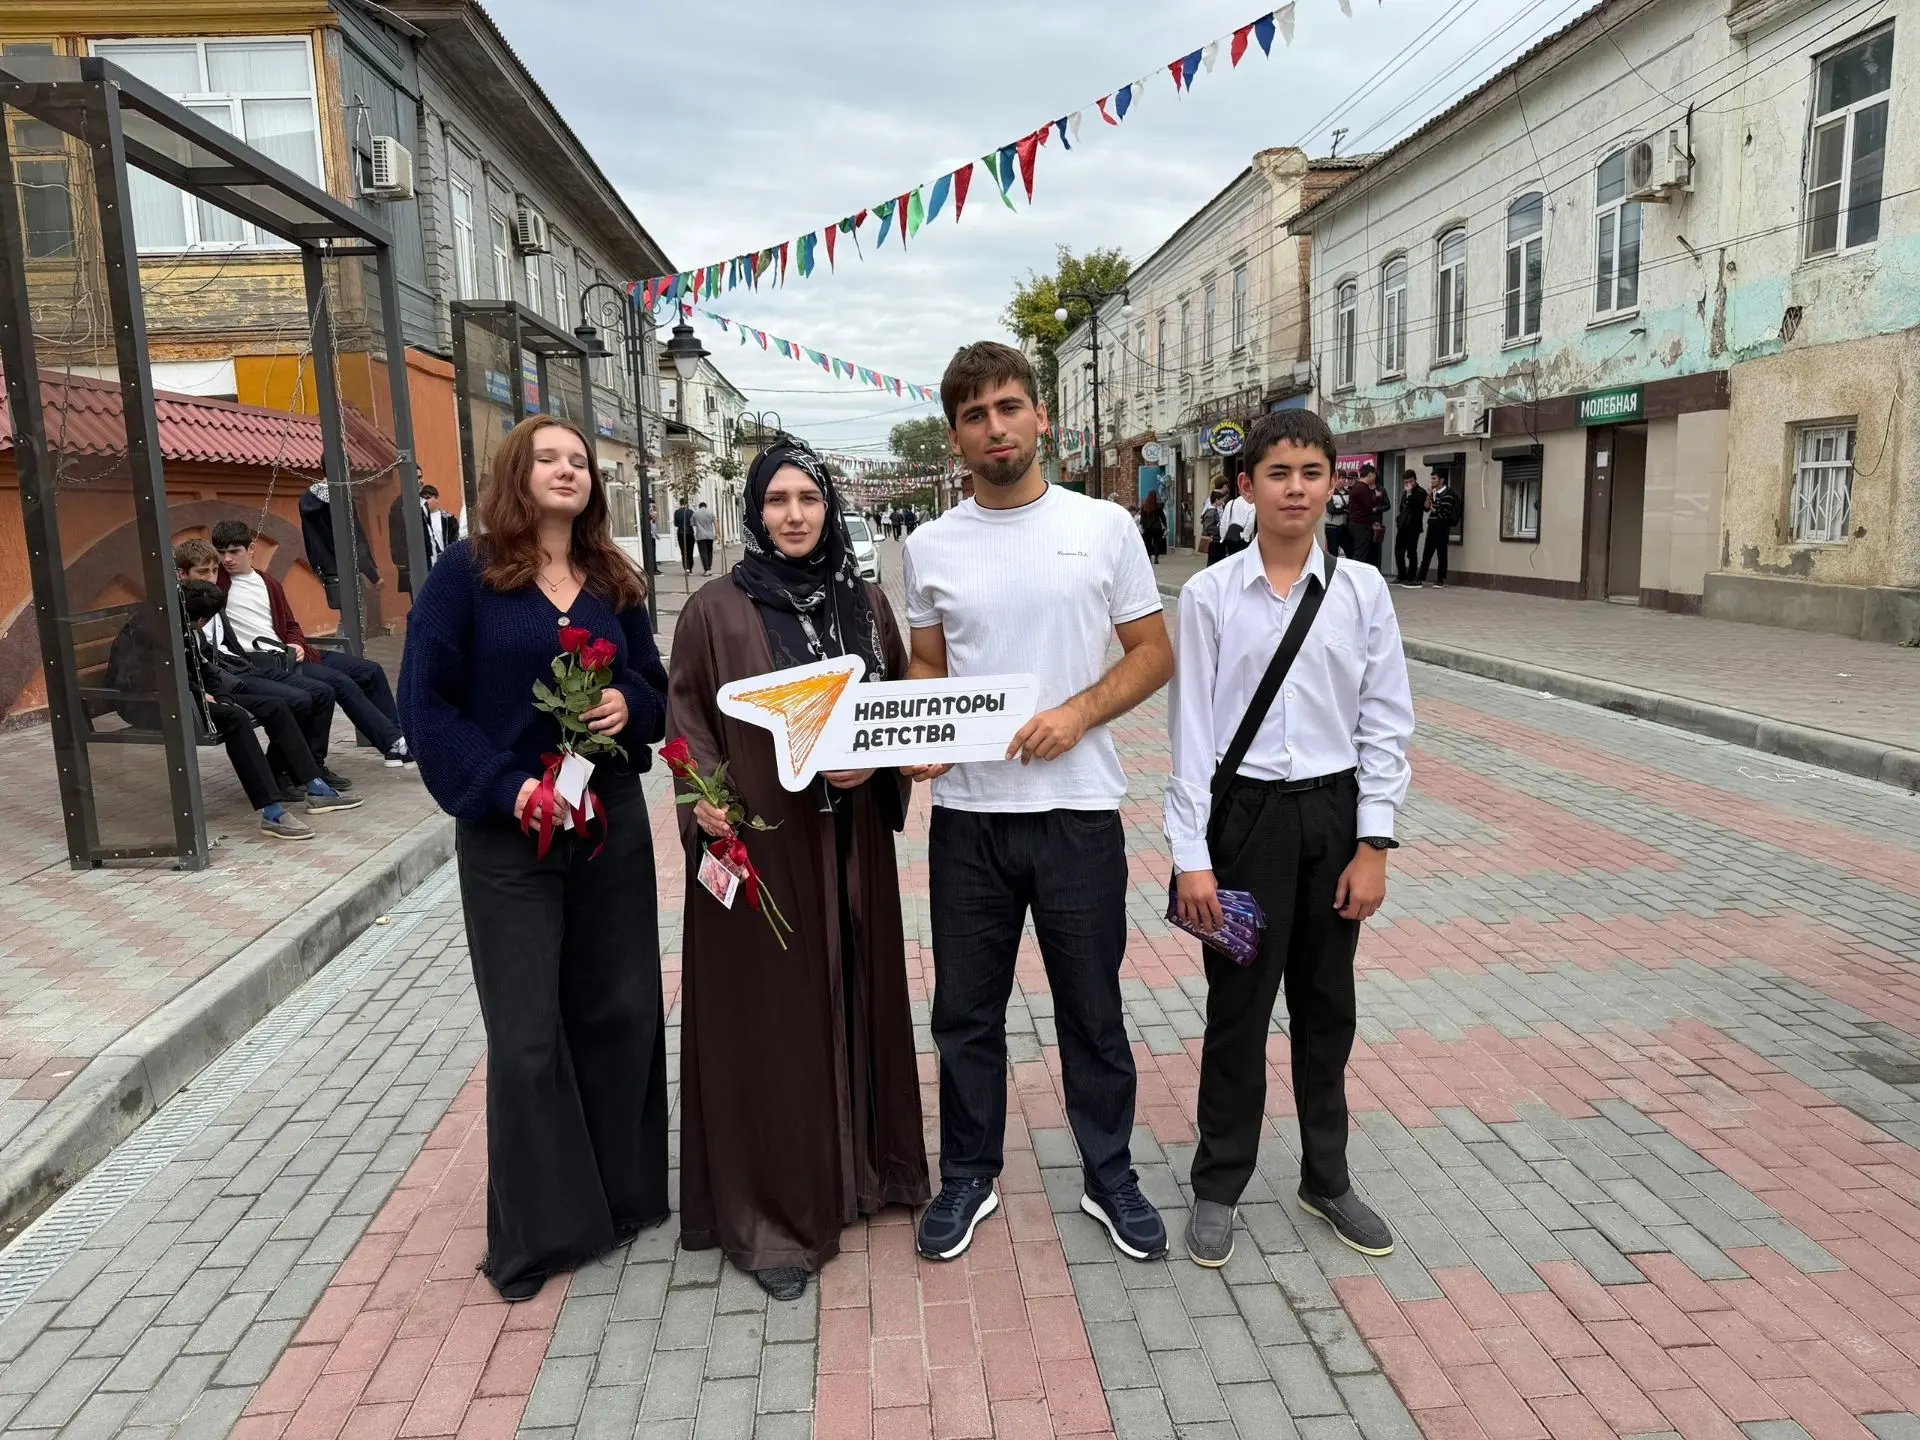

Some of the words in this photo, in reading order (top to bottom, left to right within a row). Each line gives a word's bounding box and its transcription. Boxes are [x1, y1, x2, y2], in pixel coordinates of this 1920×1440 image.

[1580, 392, 1638, 419] МОЛЕБНАЯ
[854, 693, 1005, 722] НАВИГАТОРЫ
[852, 723, 956, 752] ДЕТСТВА
